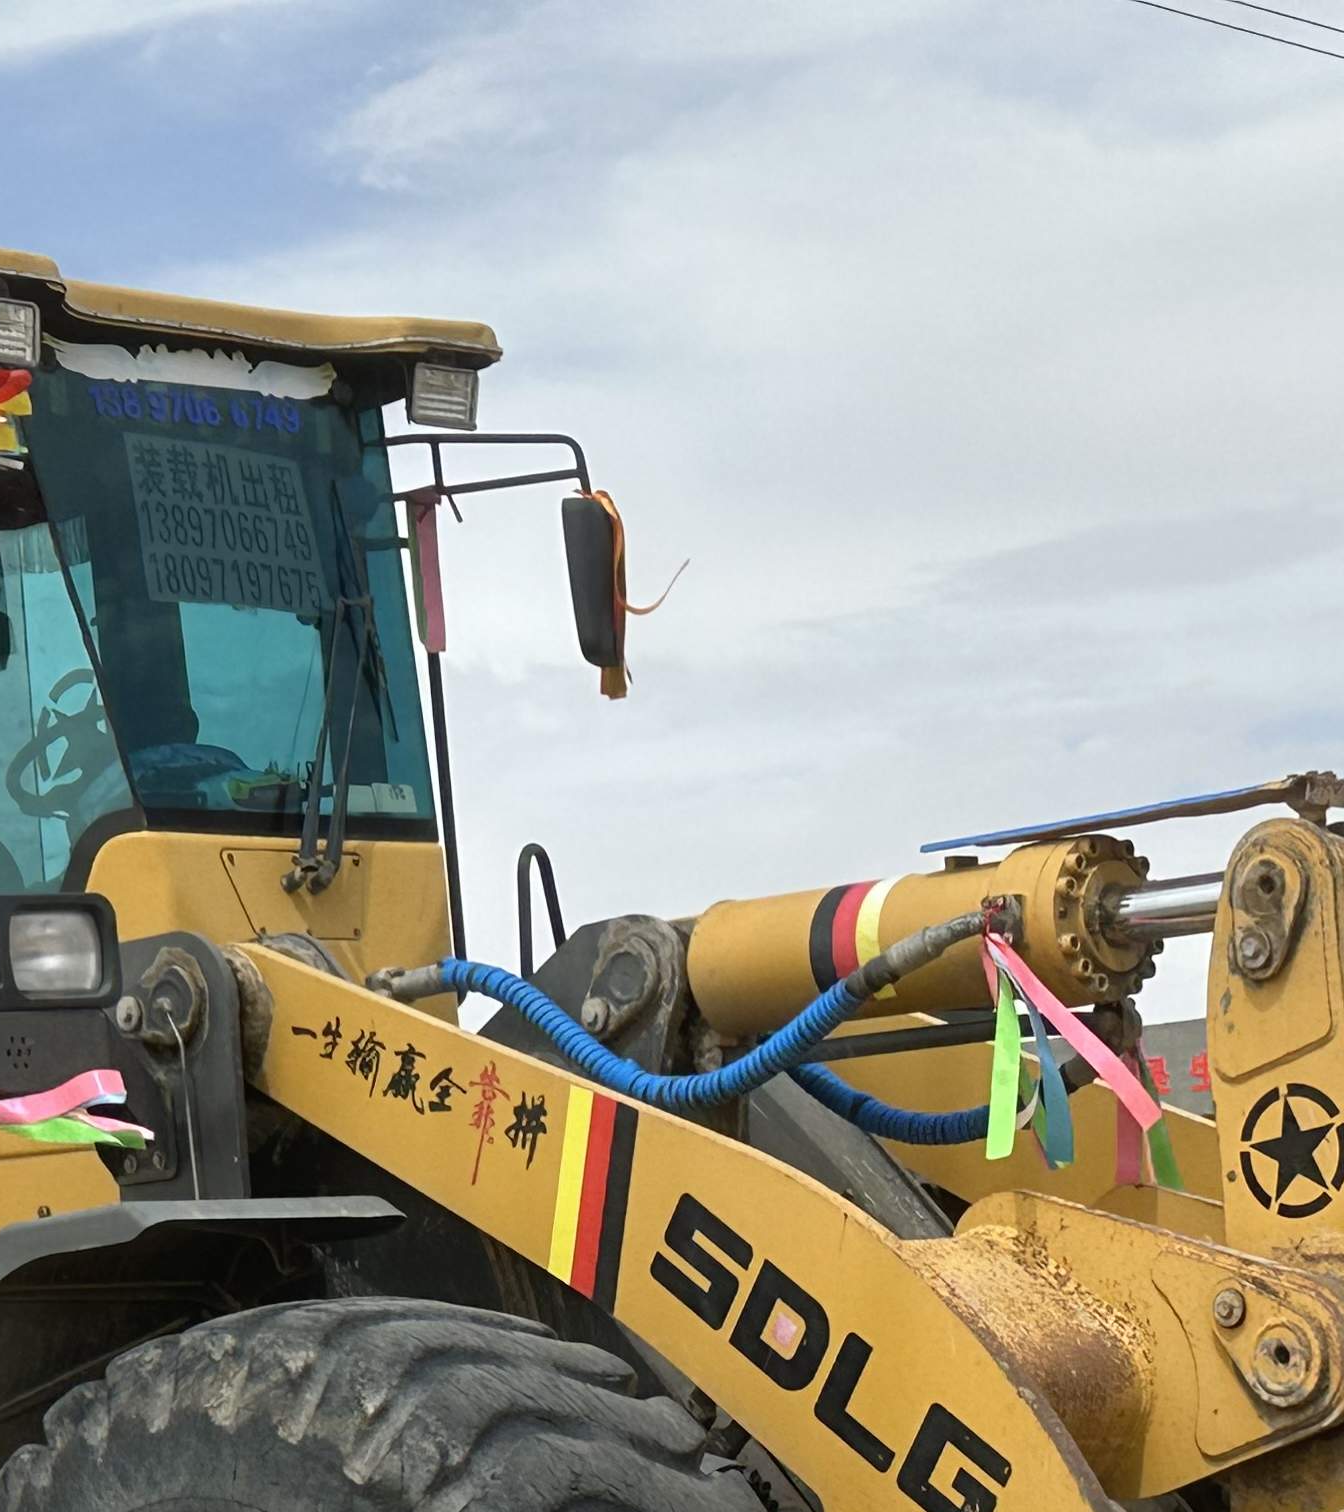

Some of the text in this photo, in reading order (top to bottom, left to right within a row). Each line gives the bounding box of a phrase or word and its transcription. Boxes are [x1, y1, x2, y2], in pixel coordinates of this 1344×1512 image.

[137, 444, 302, 515] 装载机出租
[142, 501, 311, 560] 13897066749
[151, 553, 321, 608] 18097197675
